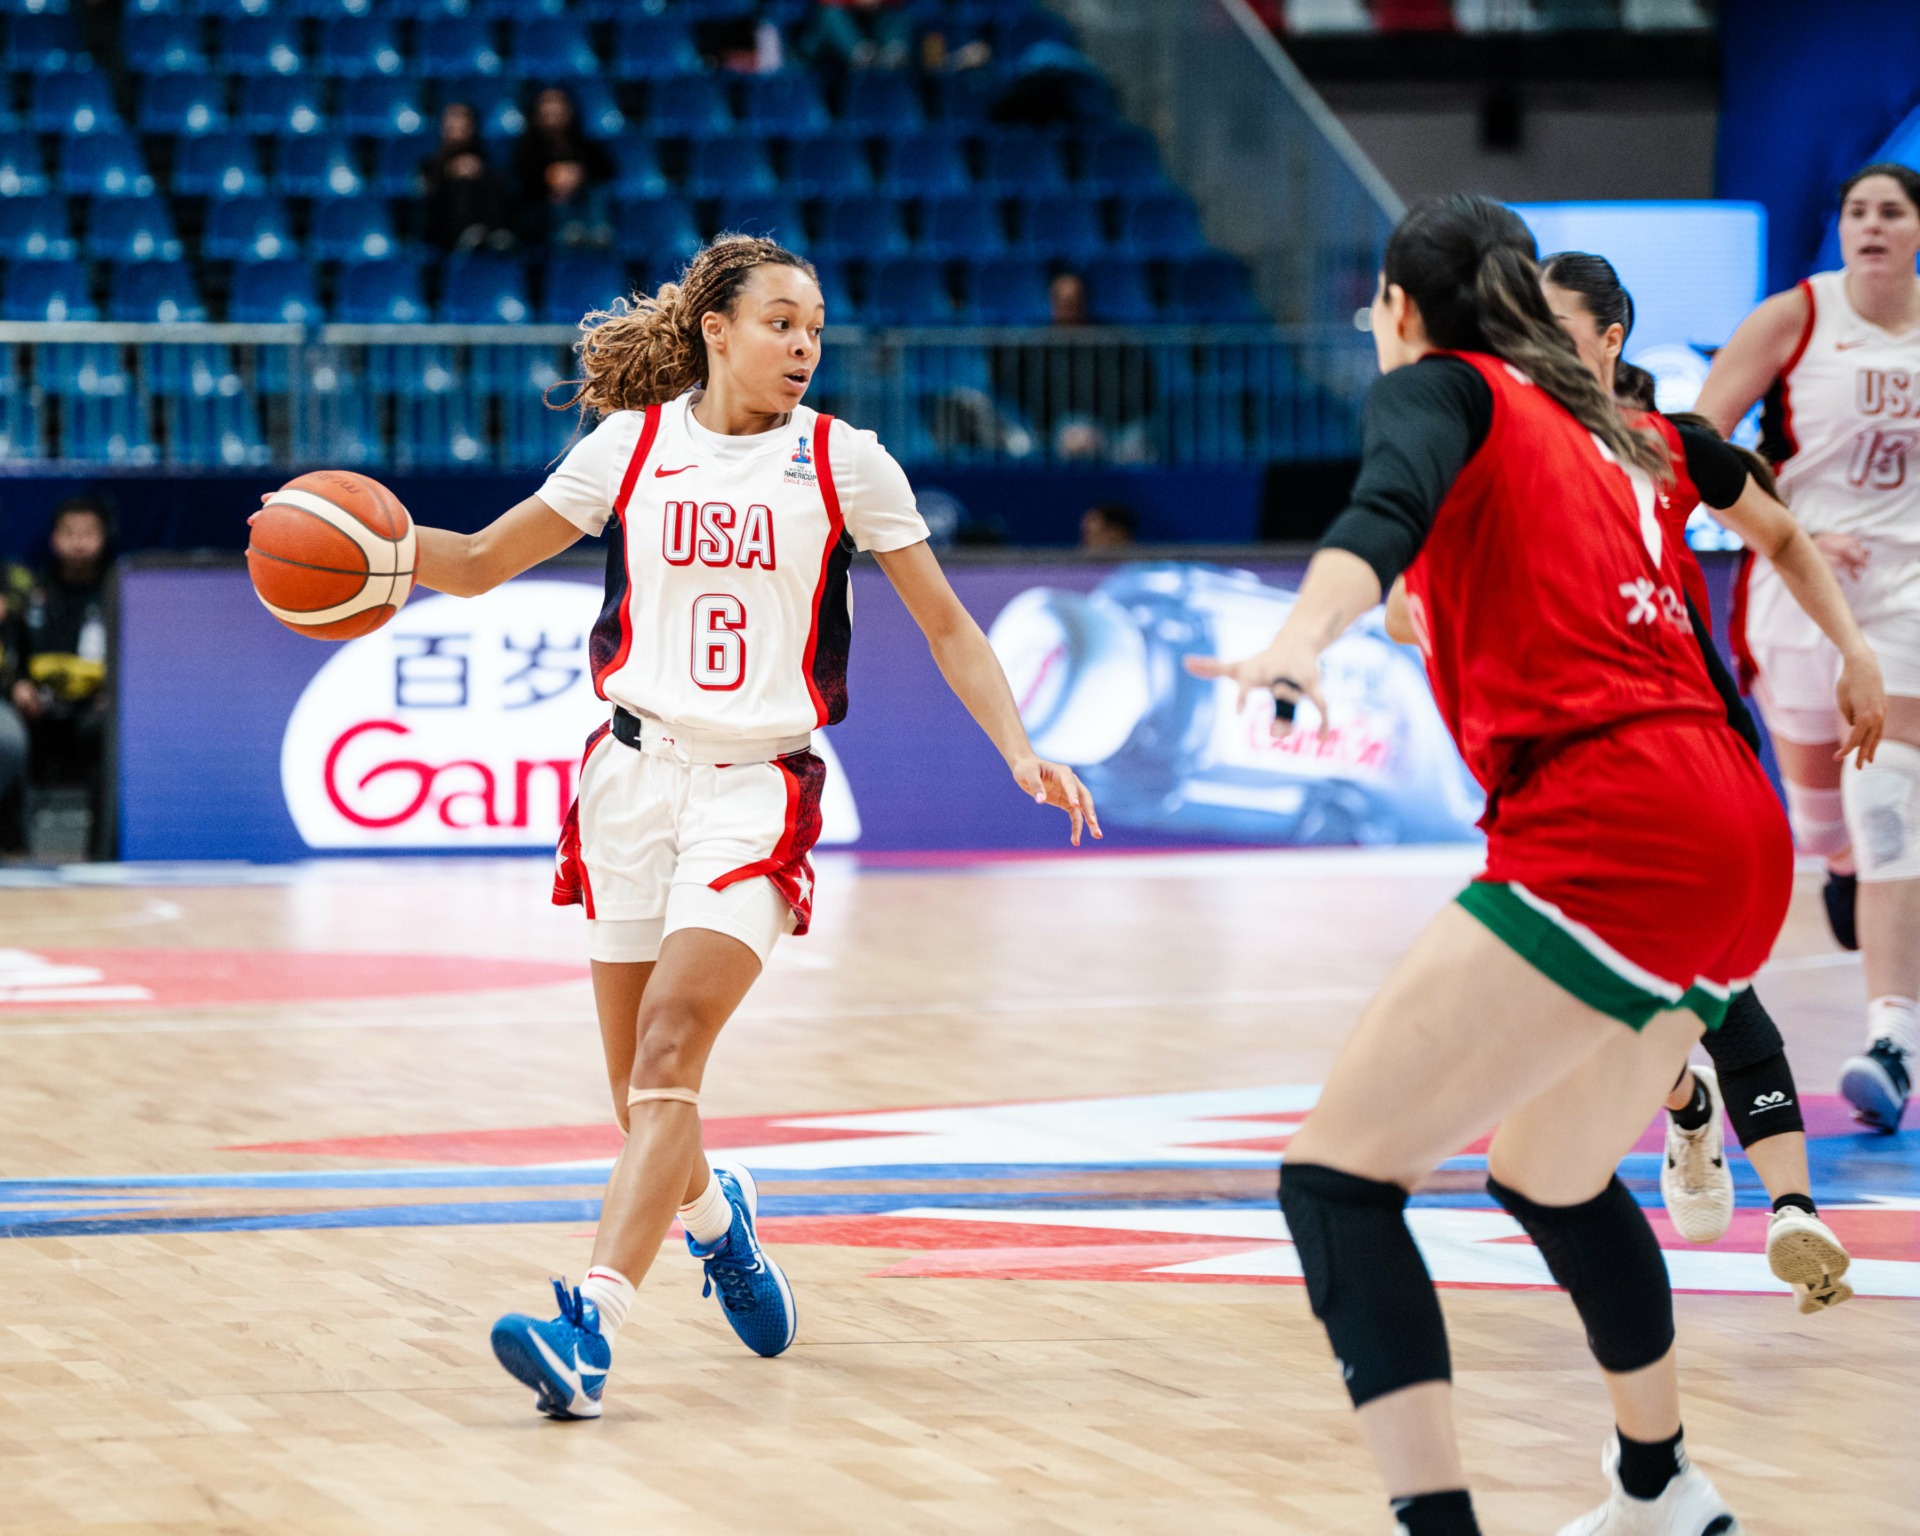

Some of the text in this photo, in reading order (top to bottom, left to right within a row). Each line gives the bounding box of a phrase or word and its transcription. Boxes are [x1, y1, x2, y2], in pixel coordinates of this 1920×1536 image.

[1856, 367, 1920, 419] US
[783, 477, 800, 485] CHILE
[784, 470, 817, 481] AMERICUP
[1848, 429, 1918, 490] 13
[663, 501, 776, 571] USA
[392, 631, 583, 711] 百岁
[690, 593, 746, 691] 6
[323, 719, 582, 830] Gan
